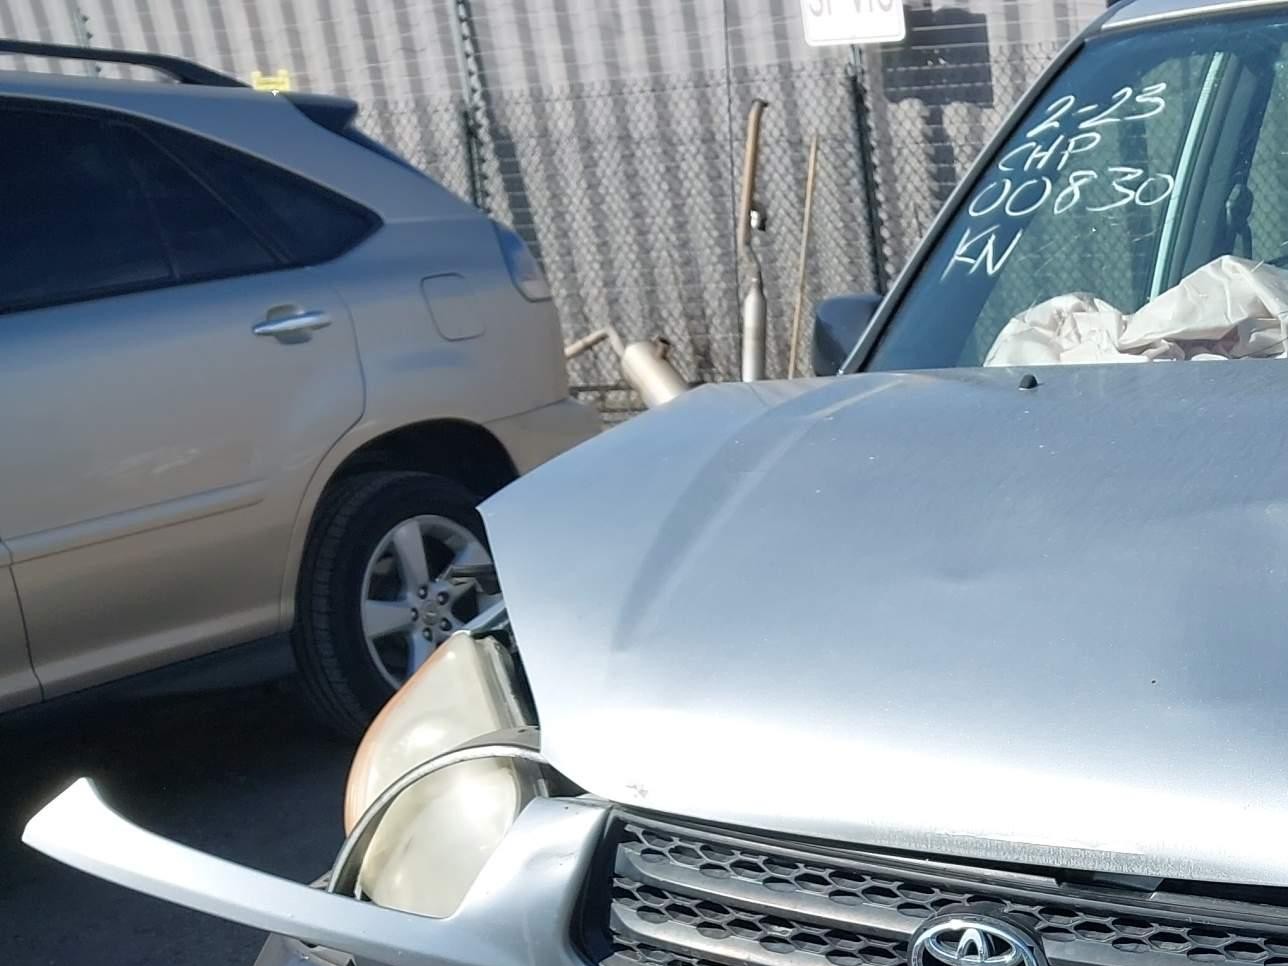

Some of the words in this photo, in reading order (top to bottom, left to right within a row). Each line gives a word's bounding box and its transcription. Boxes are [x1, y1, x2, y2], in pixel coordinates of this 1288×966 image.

[1026, 82, 1167, 138] 2-23
[998, 131, 1101, 172] CHP
[968, 166, 1175, 217] 00830
[940, 224, 1024, 282] KN
